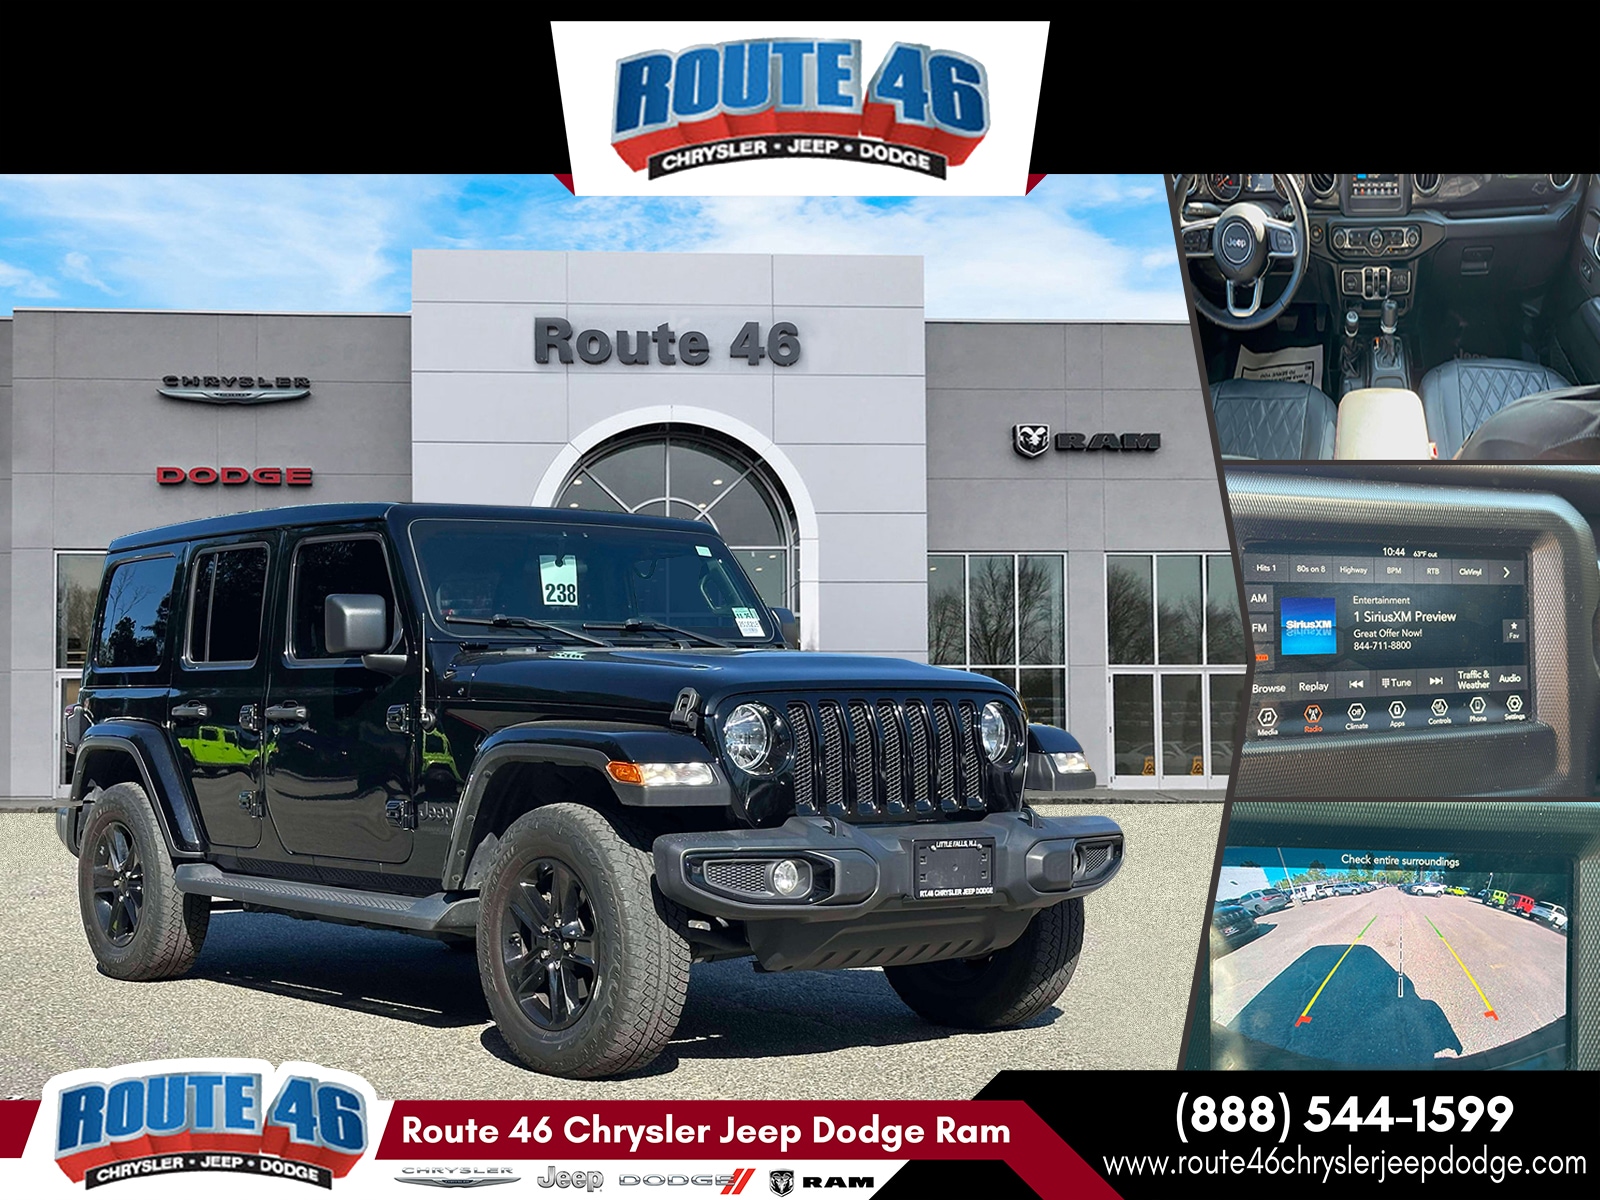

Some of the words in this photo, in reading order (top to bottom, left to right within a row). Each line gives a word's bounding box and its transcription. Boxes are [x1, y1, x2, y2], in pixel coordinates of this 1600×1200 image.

[1226, 238, 1247, 249] Jeep
[534, 316, 710, 366] Route
[730, 321, 801, 366] 46
[162, 375, 311, 389] CHRYSLER
[1054, 432, 1162, 451] RAM
[156, 466, 313, 486] DODGE
[1382, 547, 1405, 557] 10:44
[1256, 564, 1271, 572] Hits
[1273, 564, 1277, 572] 1
[1296, 564, 1309, 573] 80s
[1320, 565, 1326, 573] 8
[1339, 565, 1369, 575] Highway
[1386, 566, 1402, 574] BPM
[1426, 567, 1440, 575] RTB
[544, 583, 577, 604] 238
[1250, 593, 1268, 603] AM
[1352, 596, 1411, 605] Entertainment
[1353, 611, 1360, 623] 1
[1364, 610, 1412, 623] SiriusXM
[1415, 611, 1457, 622] Preview
[1251, 623, 1268, 632] FM
[1285, 619, 1332, 629] SiriusXM
[1353, 629, 1378, 639] Great
[1378, 628, 1400, 638] Offer
[1401, 628, 1423, 638] Now!
[1353, 640, 1412, 651] 844-711-8800
[1457, 669, 1482, 679] Traffic
[1482, 669, 1490, 679] &
[1499, 673, 1522, 683] Audio
[1298, 681, 1330, 692] Replay
[1391, 678, 1412, 687] Tune
[1457, 680, 1491, 690] Weather
[1251, 683, 1287, 694] Browse
[1351, 708, 1361, 716] Off
[1504, 713, 1526, 721] Settings
[1389, 720, 1406, 728] Apps
[1428, 716, 1452, 725] Controls
[1469, 715, 1488, 723] Phone
[1304, 725, 1323, 733] Radio
[1345, 722, 1369, 731] Climate
[1257, 728, 1279, 736] Media
[419, 800, 455, 825] Jeep
[935, 840, 953, 849] LITTLE
[1341, 853, 1372, 866] Check
[1373, 855, 1400, 866] entire
[1401, 855, 1460, 869] surroundings
[934, 888, 962, 897] CHRYSLER
[962, 887, 976, 896] JEEP
[975, 886, 994, 895] DODGE
